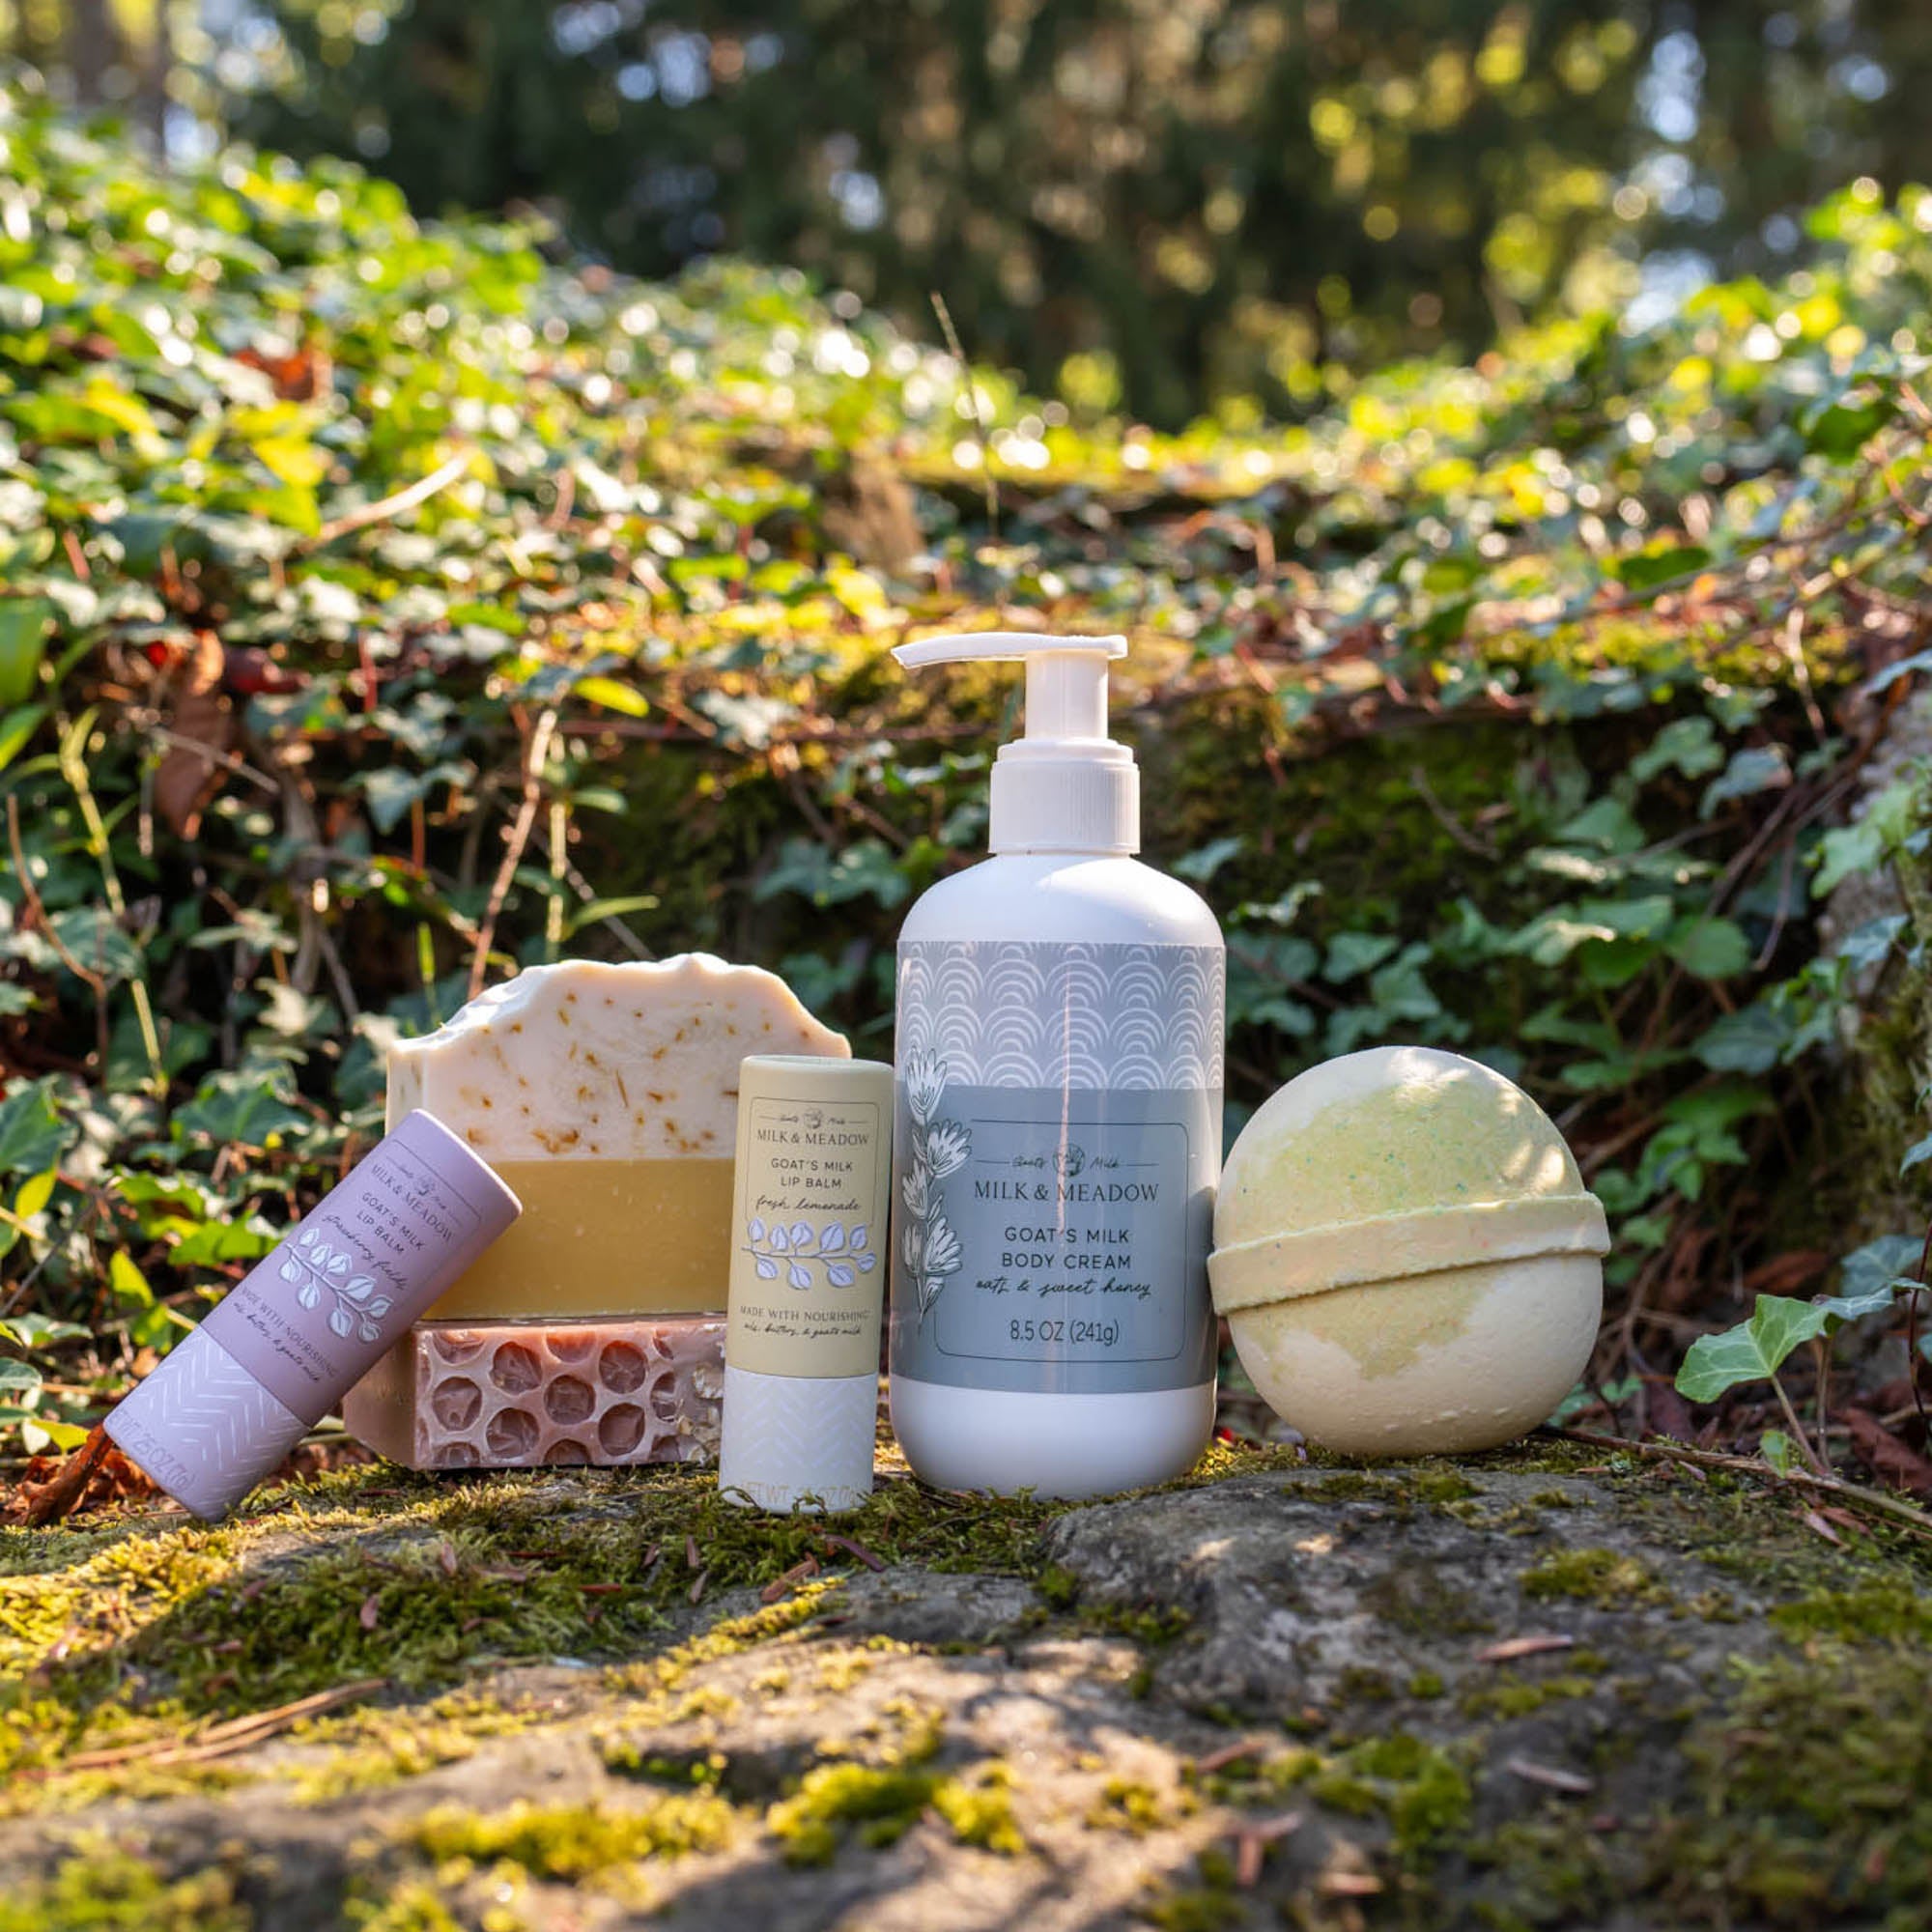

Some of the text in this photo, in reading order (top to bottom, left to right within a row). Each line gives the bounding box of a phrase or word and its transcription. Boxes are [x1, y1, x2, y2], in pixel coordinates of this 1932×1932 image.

[757, 1129, 868, 1146] MILK & MEADOW
[771, 1158, 853, 1172] GOAT'S MILK
[781, 1177, 841, 1189] LIP BALM
[975, 1180, 1159, 1202] MILK & MEADOW
[371, 1165, 394, 1188] MILK
[392, 1183, 403, 1195] &
[406, 1191, 455, 1242] MEADOW
[755, 1195, 861, 1211] fresh lemonade
[362, 1192, 426, 1252] GOAT'S MILK
[356, 1210, 405, 1255] LIP BALM
[1087, 1228, 1130, 1244] MILK
[1002, 1253, 1131, 1269] BODY CREAM
[1017, 1279, 1029, 1292] &
[1038, 1278, 1094, 1297] sweet
[1101, 1277, 1151, 1300] honey
[740, 1305, 870, 1322] MADE WITH NOURISHING
[1010, 1320, 1119, 1347] 8.5 OZ (241g)
